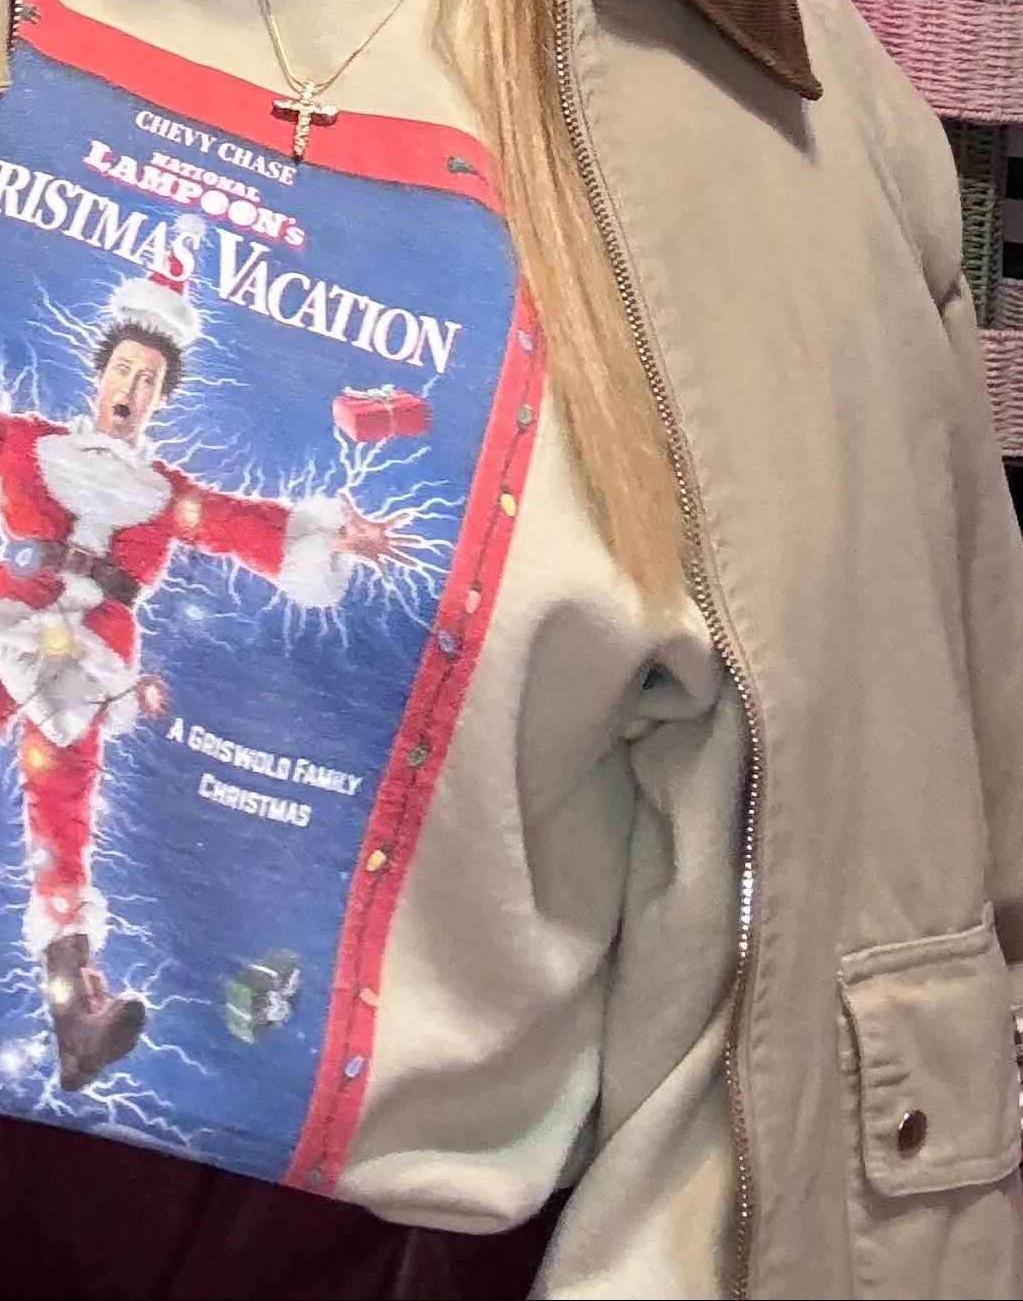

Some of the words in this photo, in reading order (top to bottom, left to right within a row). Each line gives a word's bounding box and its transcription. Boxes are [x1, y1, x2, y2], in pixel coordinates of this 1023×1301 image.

[135, 110, 217, 153] CHEVY
[217, 142, 297, 186] CHASE
[149, 151, 261, 202] NATIONAL
[214, 227, 463, 374] VACATION
[165, 717, 185, 743] A
[187, 725, 292, 780] GRISWOLD
[292, 758, 363, 796] FAMILY
[198, 773, 313, 828] CHRISTMAS
